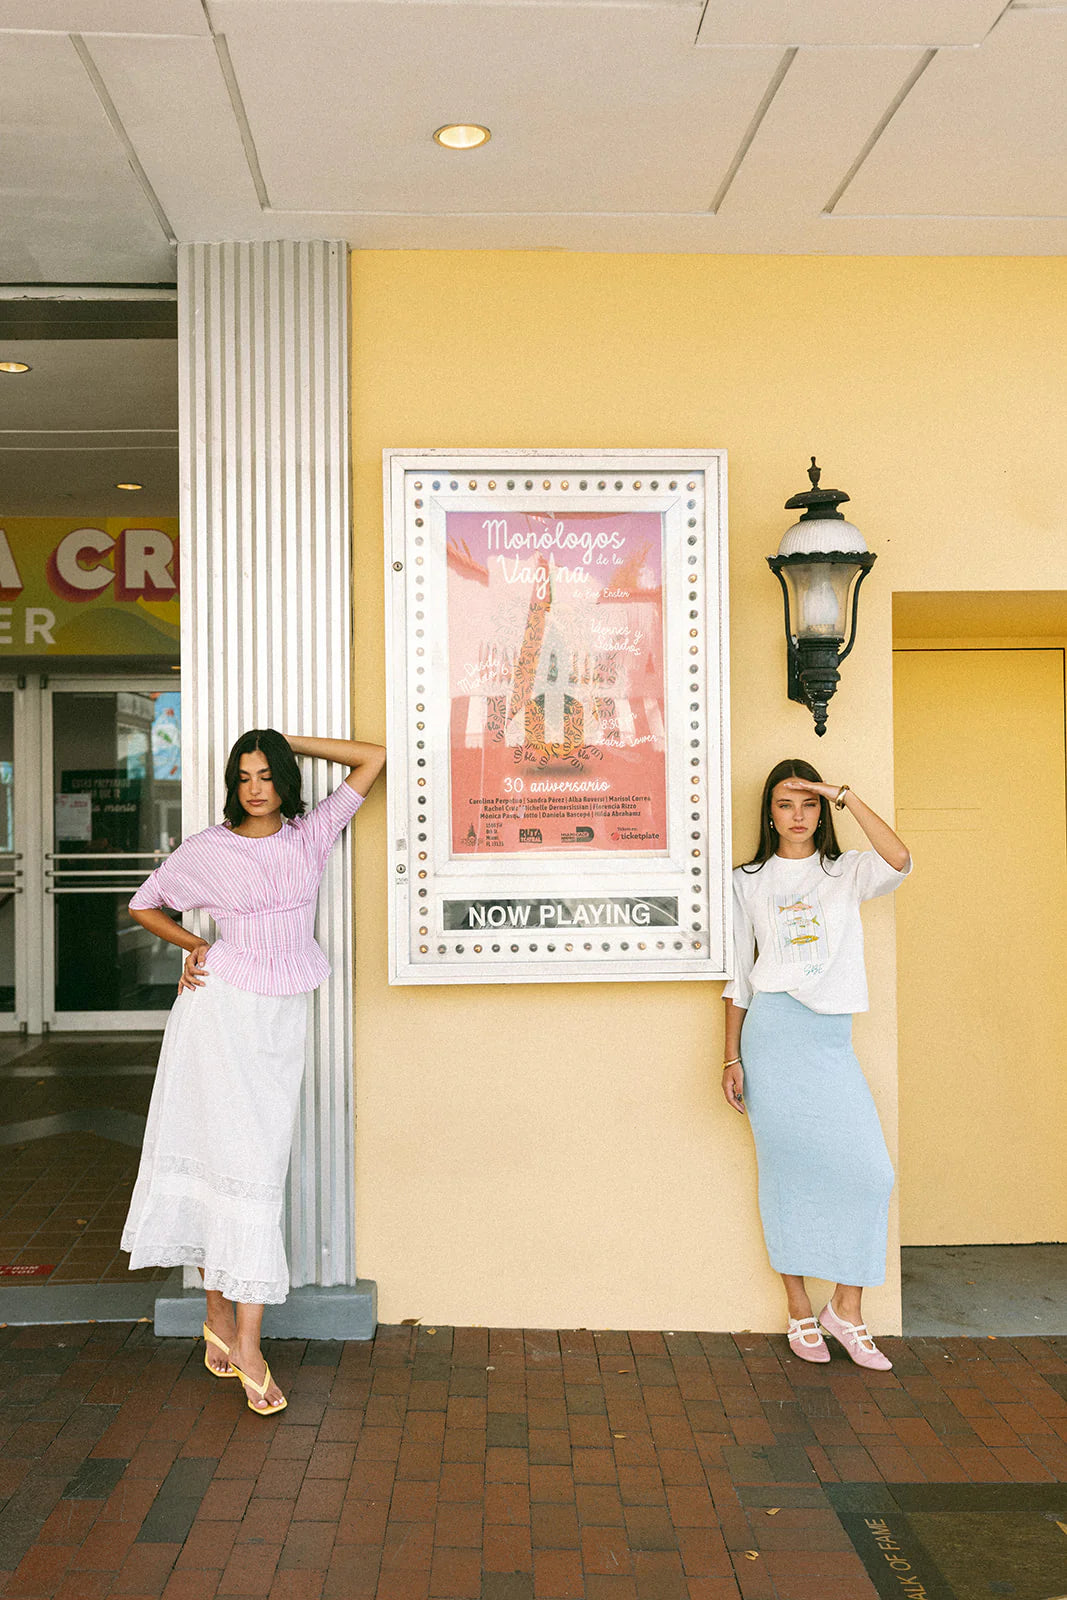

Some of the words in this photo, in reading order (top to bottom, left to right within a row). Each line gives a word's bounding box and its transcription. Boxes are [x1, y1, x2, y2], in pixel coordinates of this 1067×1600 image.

[482, 519, 626, 565] Monólogos
[596, 553, 610, 566] de
[612, 553, 624, 566] la
[503, 777, 524, 793] 30
[529, 777, 611, 793] aniversario
[526, 796, 547, 804] Sandra
[519, 828, 542, 838] RUTA
[621, 831, 660, 841] ticketplate
[468, 905, 531, 928] NOW
[539, 903, 651, 926] PLAYING
[864, 1518, 901, 1551] FAME
[884, 1553, 912, 1571] OF
